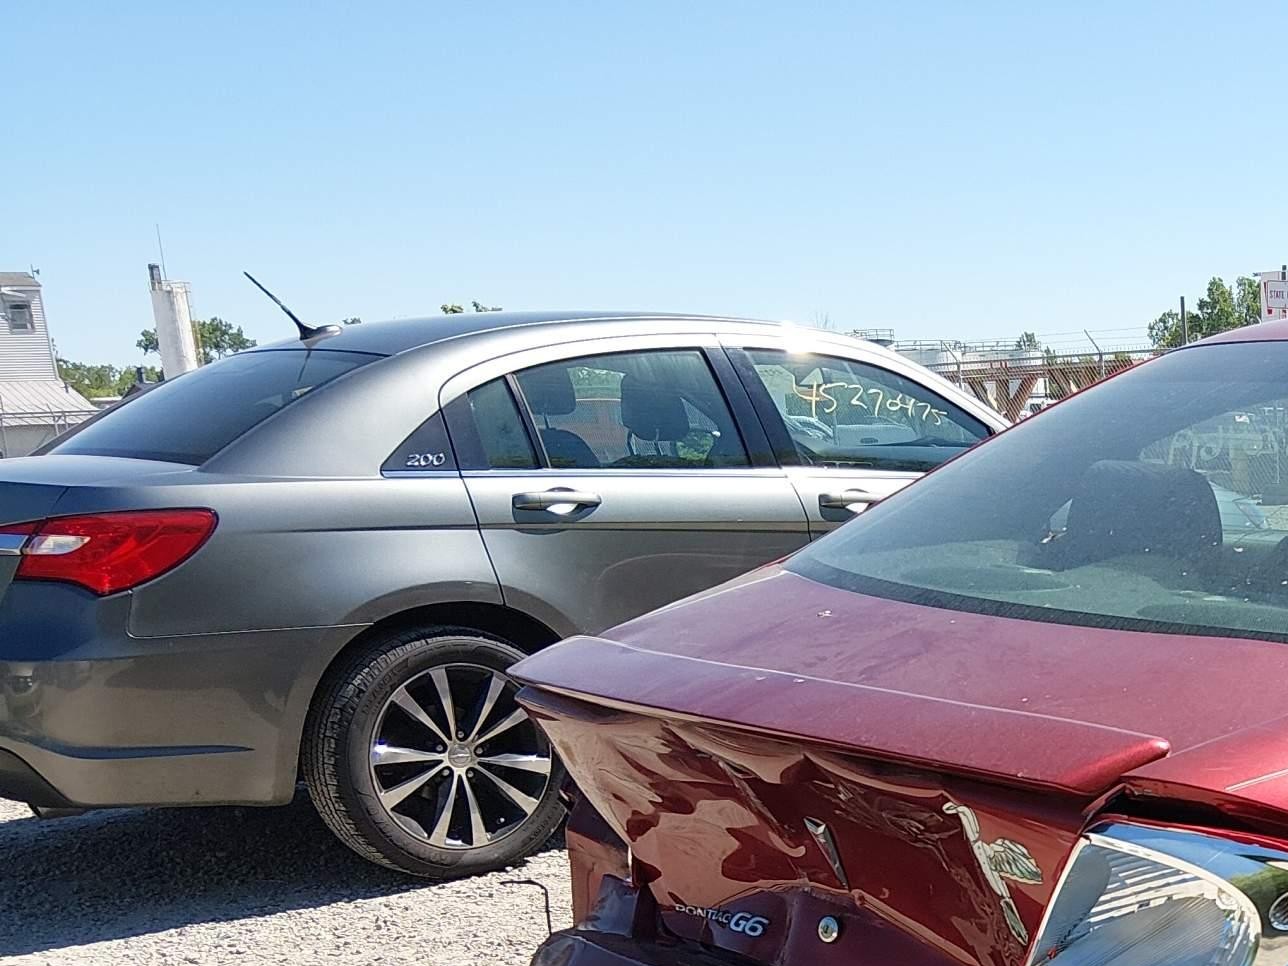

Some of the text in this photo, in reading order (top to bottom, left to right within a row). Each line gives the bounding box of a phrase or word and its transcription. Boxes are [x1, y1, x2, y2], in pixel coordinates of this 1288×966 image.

[1269, 290, 1284, 299] STATE
[406, 453, 445, 466] 200
[675, 903, 770, 937] PONTIAC G6
